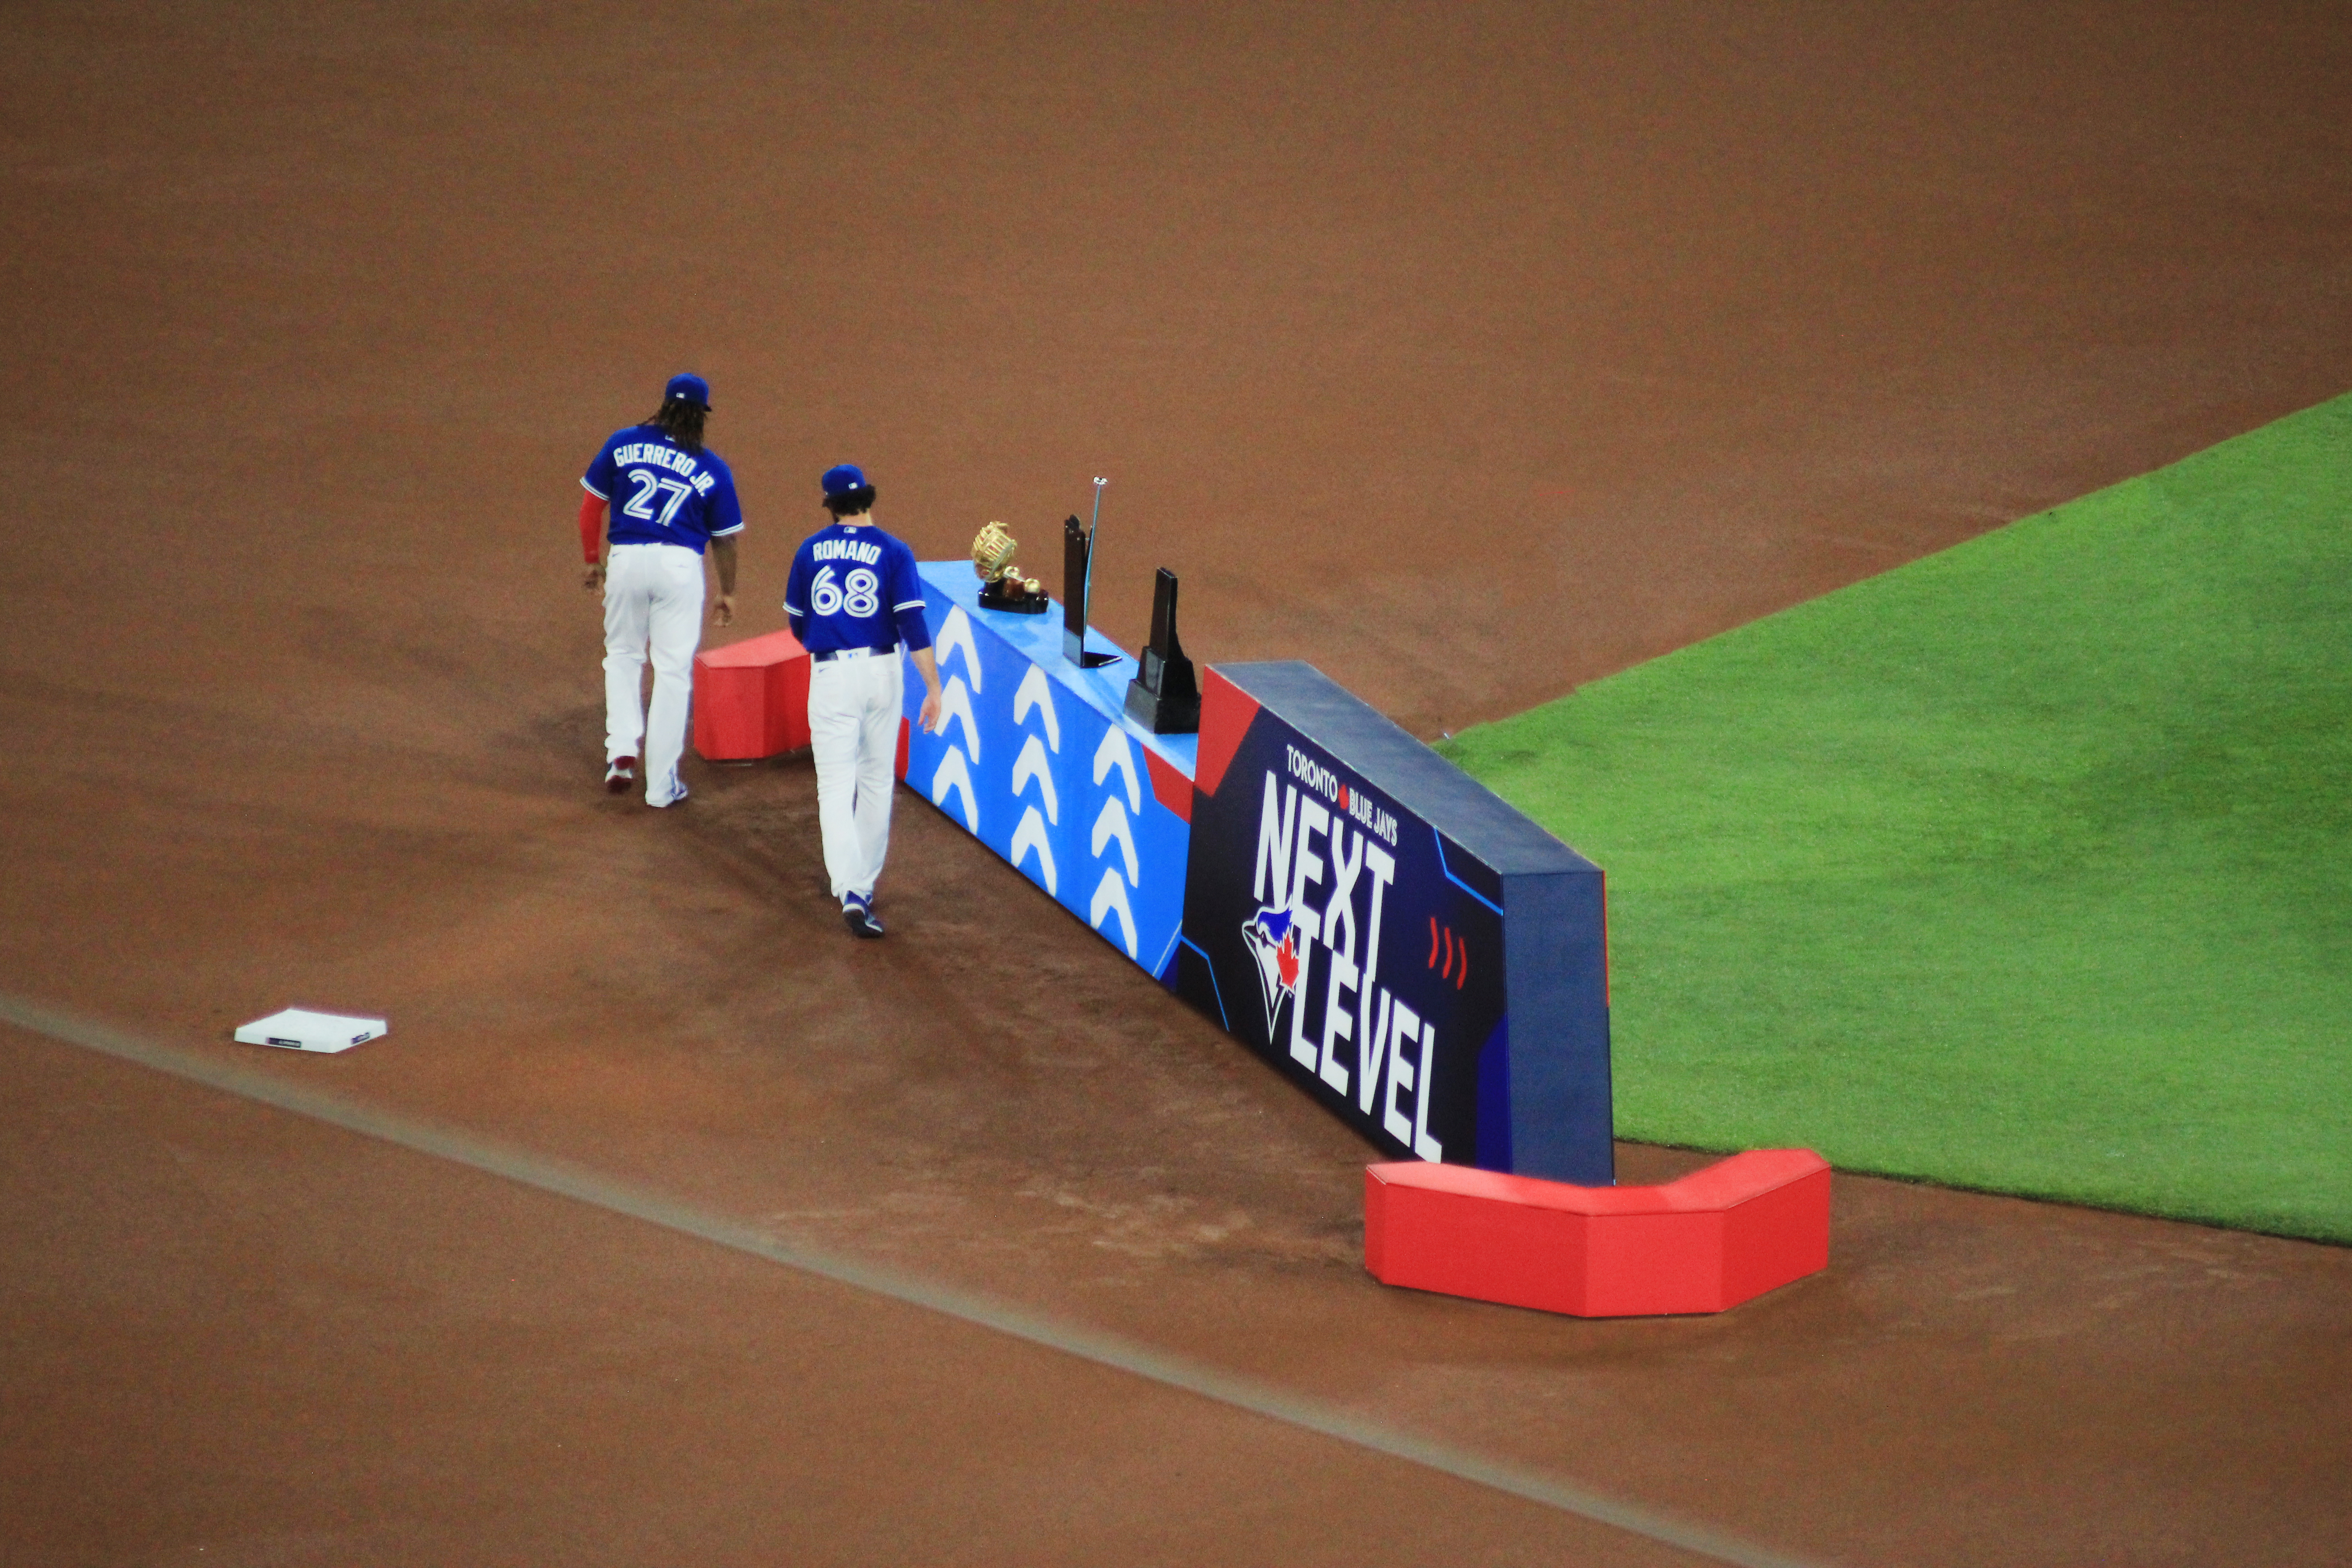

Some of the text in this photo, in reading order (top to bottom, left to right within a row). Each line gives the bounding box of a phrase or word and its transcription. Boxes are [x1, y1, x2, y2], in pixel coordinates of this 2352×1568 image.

[613, 443, 715, 497] GUERRERO JR.
[623, 469, 692, 527] 27
[813, 539, 882, 565] ROMANO
[811, 565, 879, 618] 68
[1287, 744, 1397, 847] TORONTO BLUE JAYS
[1254, 770, 1396, 982] NEXT
[1290, 926, 1442, 1164] LEVEL
